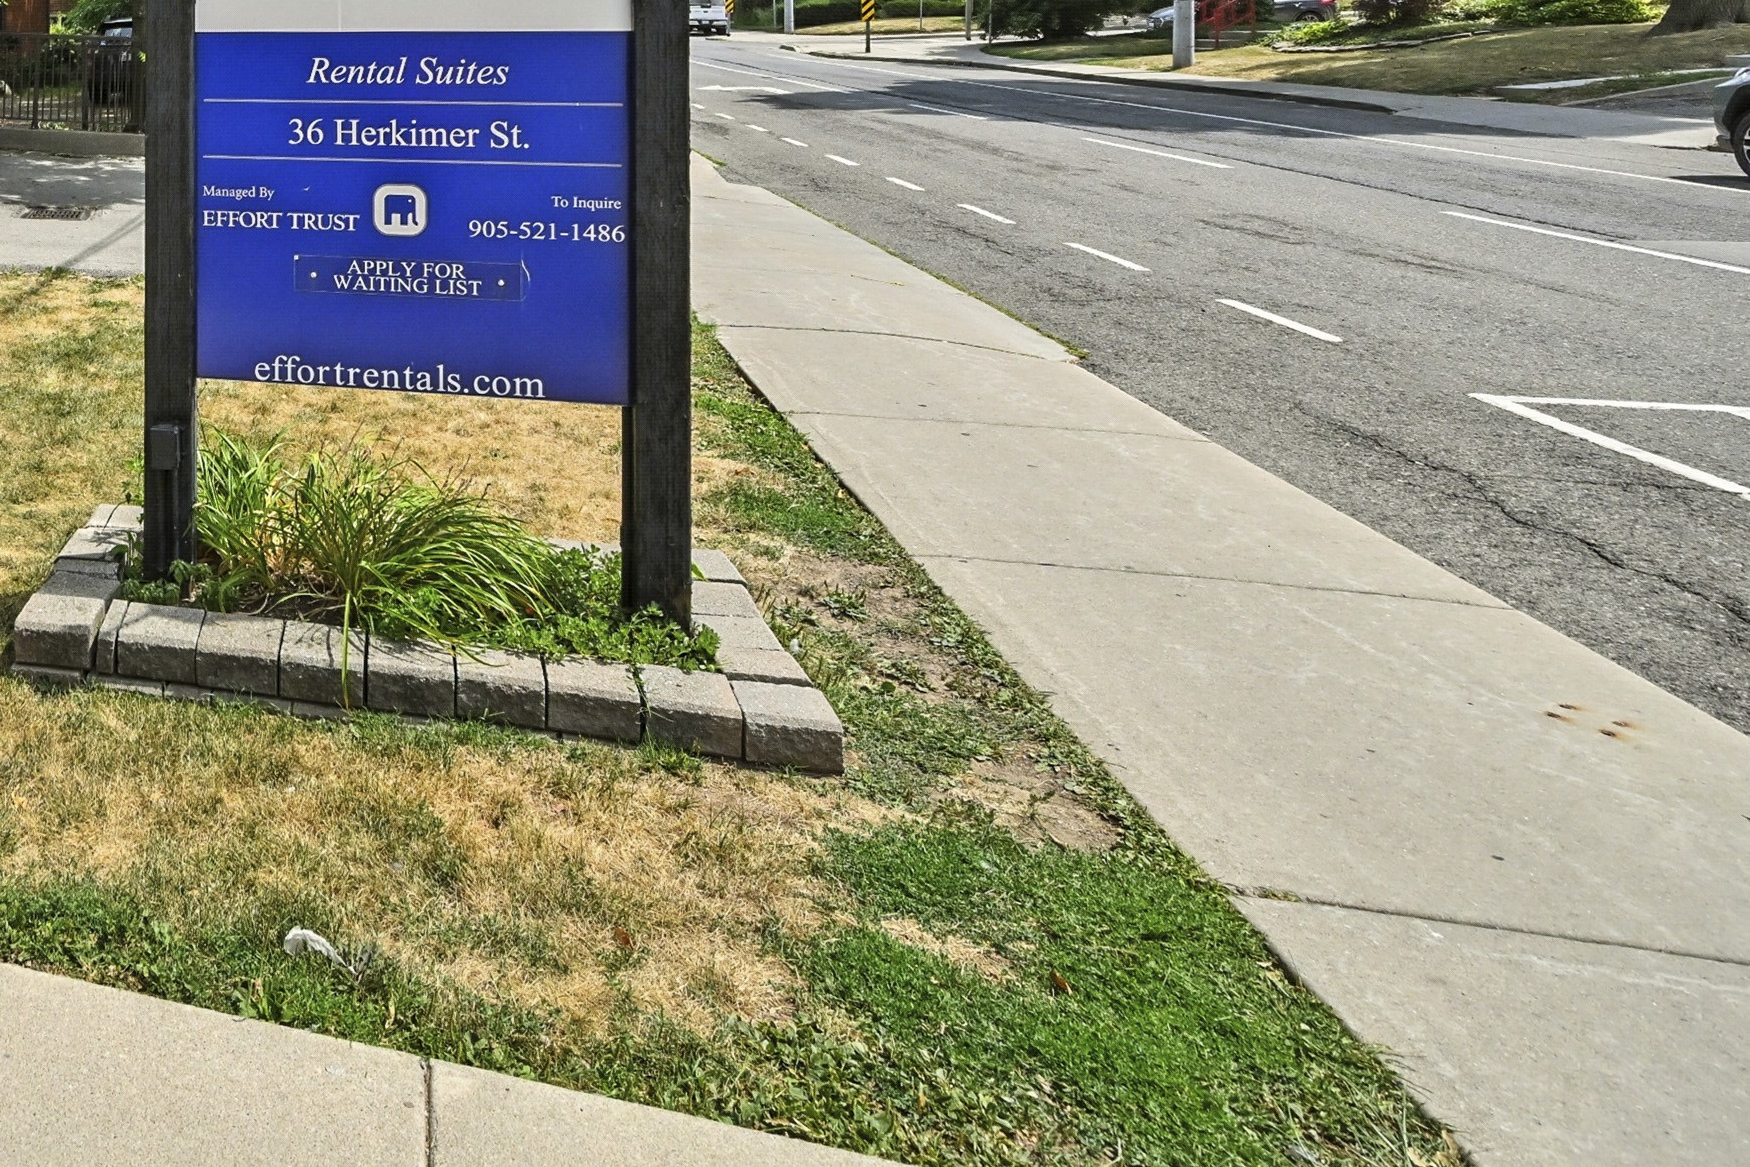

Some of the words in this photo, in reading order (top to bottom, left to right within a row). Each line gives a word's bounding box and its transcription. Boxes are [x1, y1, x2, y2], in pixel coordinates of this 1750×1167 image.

[306, 55, 407, 85] Rental
[414, 56, 510, 86] Suites
[288, 118, 324, 146] 36
[333, 118, 480, 149] Herkimer
[489, 120, 531, 150] St.
[202, 185, 256, 201] Managed
[258, 186, 275, 201] By
[551, 195, 569, 208] To
[572, 196, 622, 212] Inquire
[202, 210, 283, 229] EFFORT
[286, 212, 360, 232] TRUST
[468, 219, 626, 243] 905-521-1486
[347, 259, 417, 277] APPLY
[419, 262, 466, 280] FOR
[333, 274, 429, 294] WAITING
[434, 279, 482, 296] LIST
[253, 355, 546, 399] effortrentals.com
